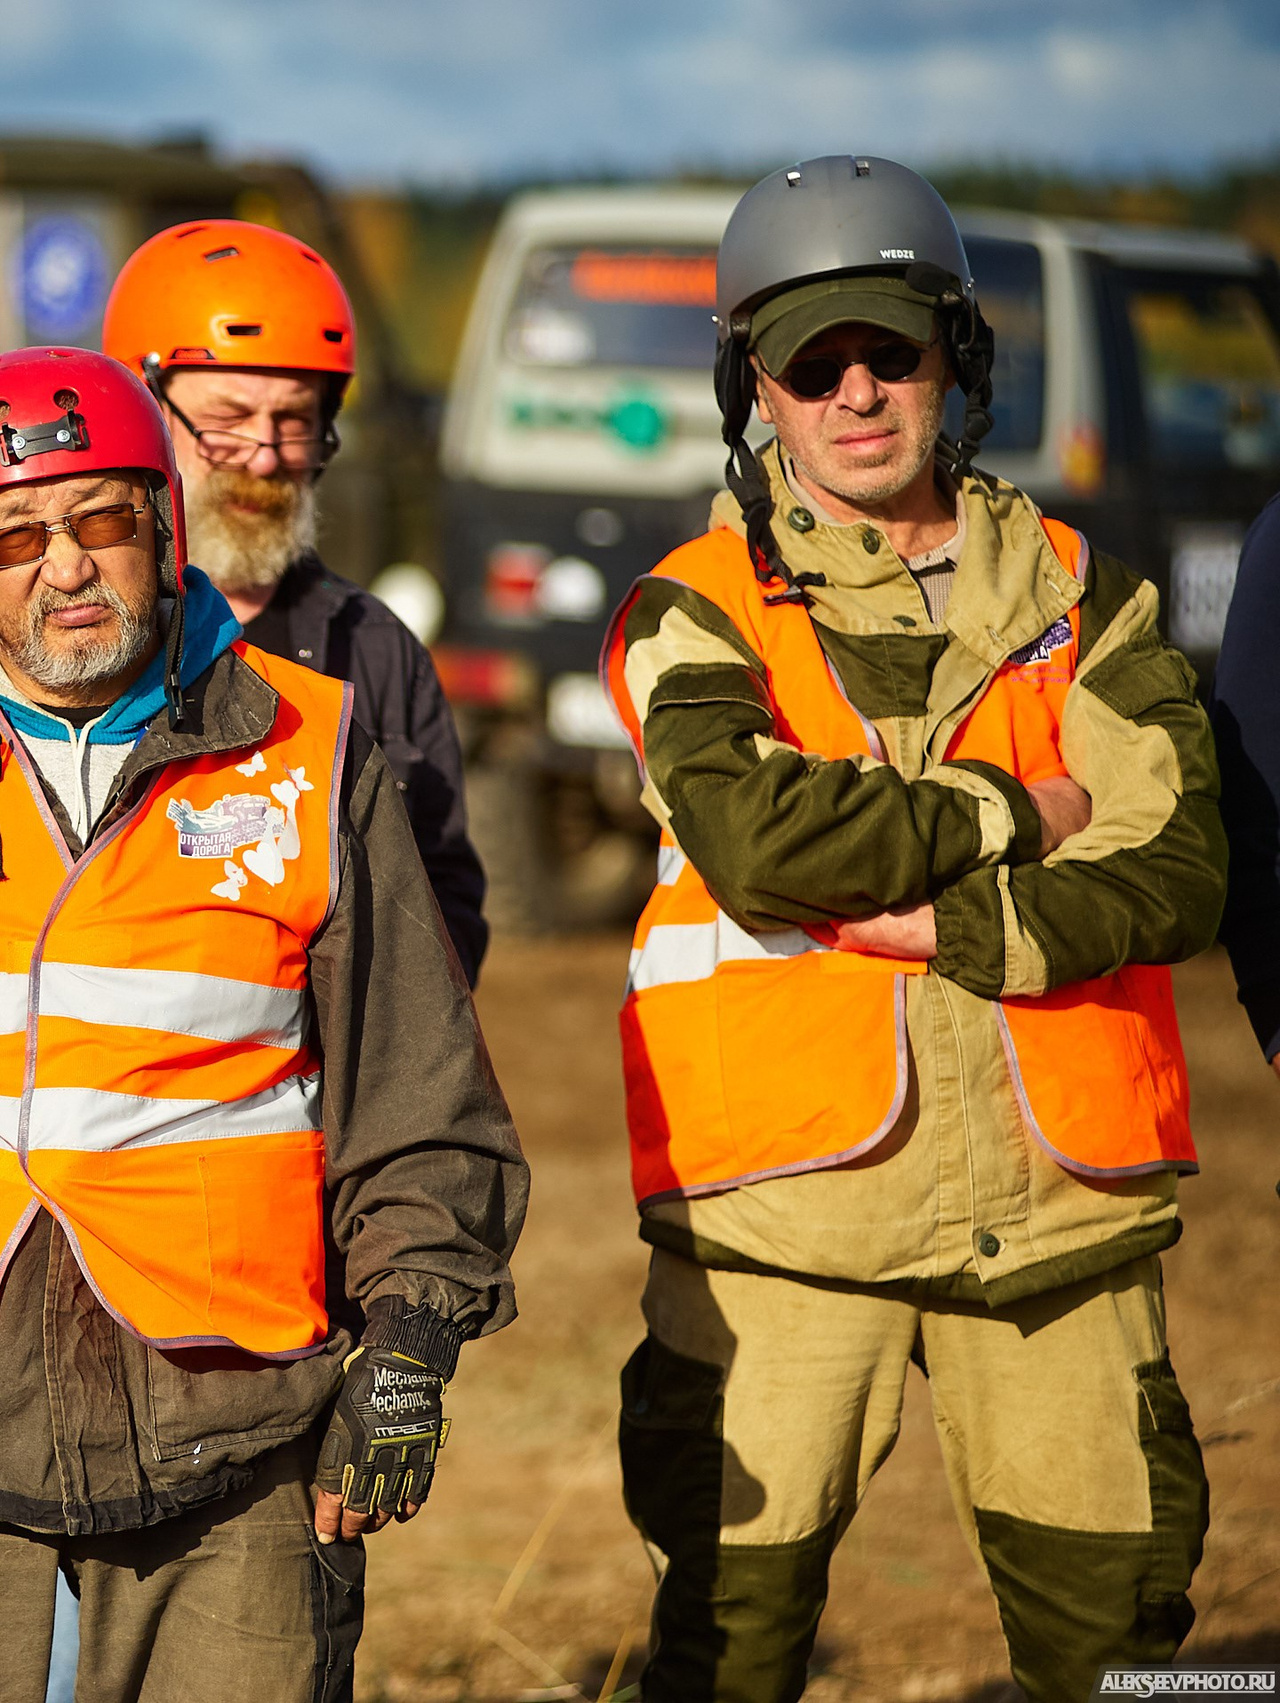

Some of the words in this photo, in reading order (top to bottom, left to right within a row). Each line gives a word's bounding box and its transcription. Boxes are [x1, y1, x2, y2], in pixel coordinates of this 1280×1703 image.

[880, 249, 915, 260] WEDZE
[180, 832, 232, 846] ОТКРЫТАЯ
[192, 843, 231, 857] ДОРОГА
